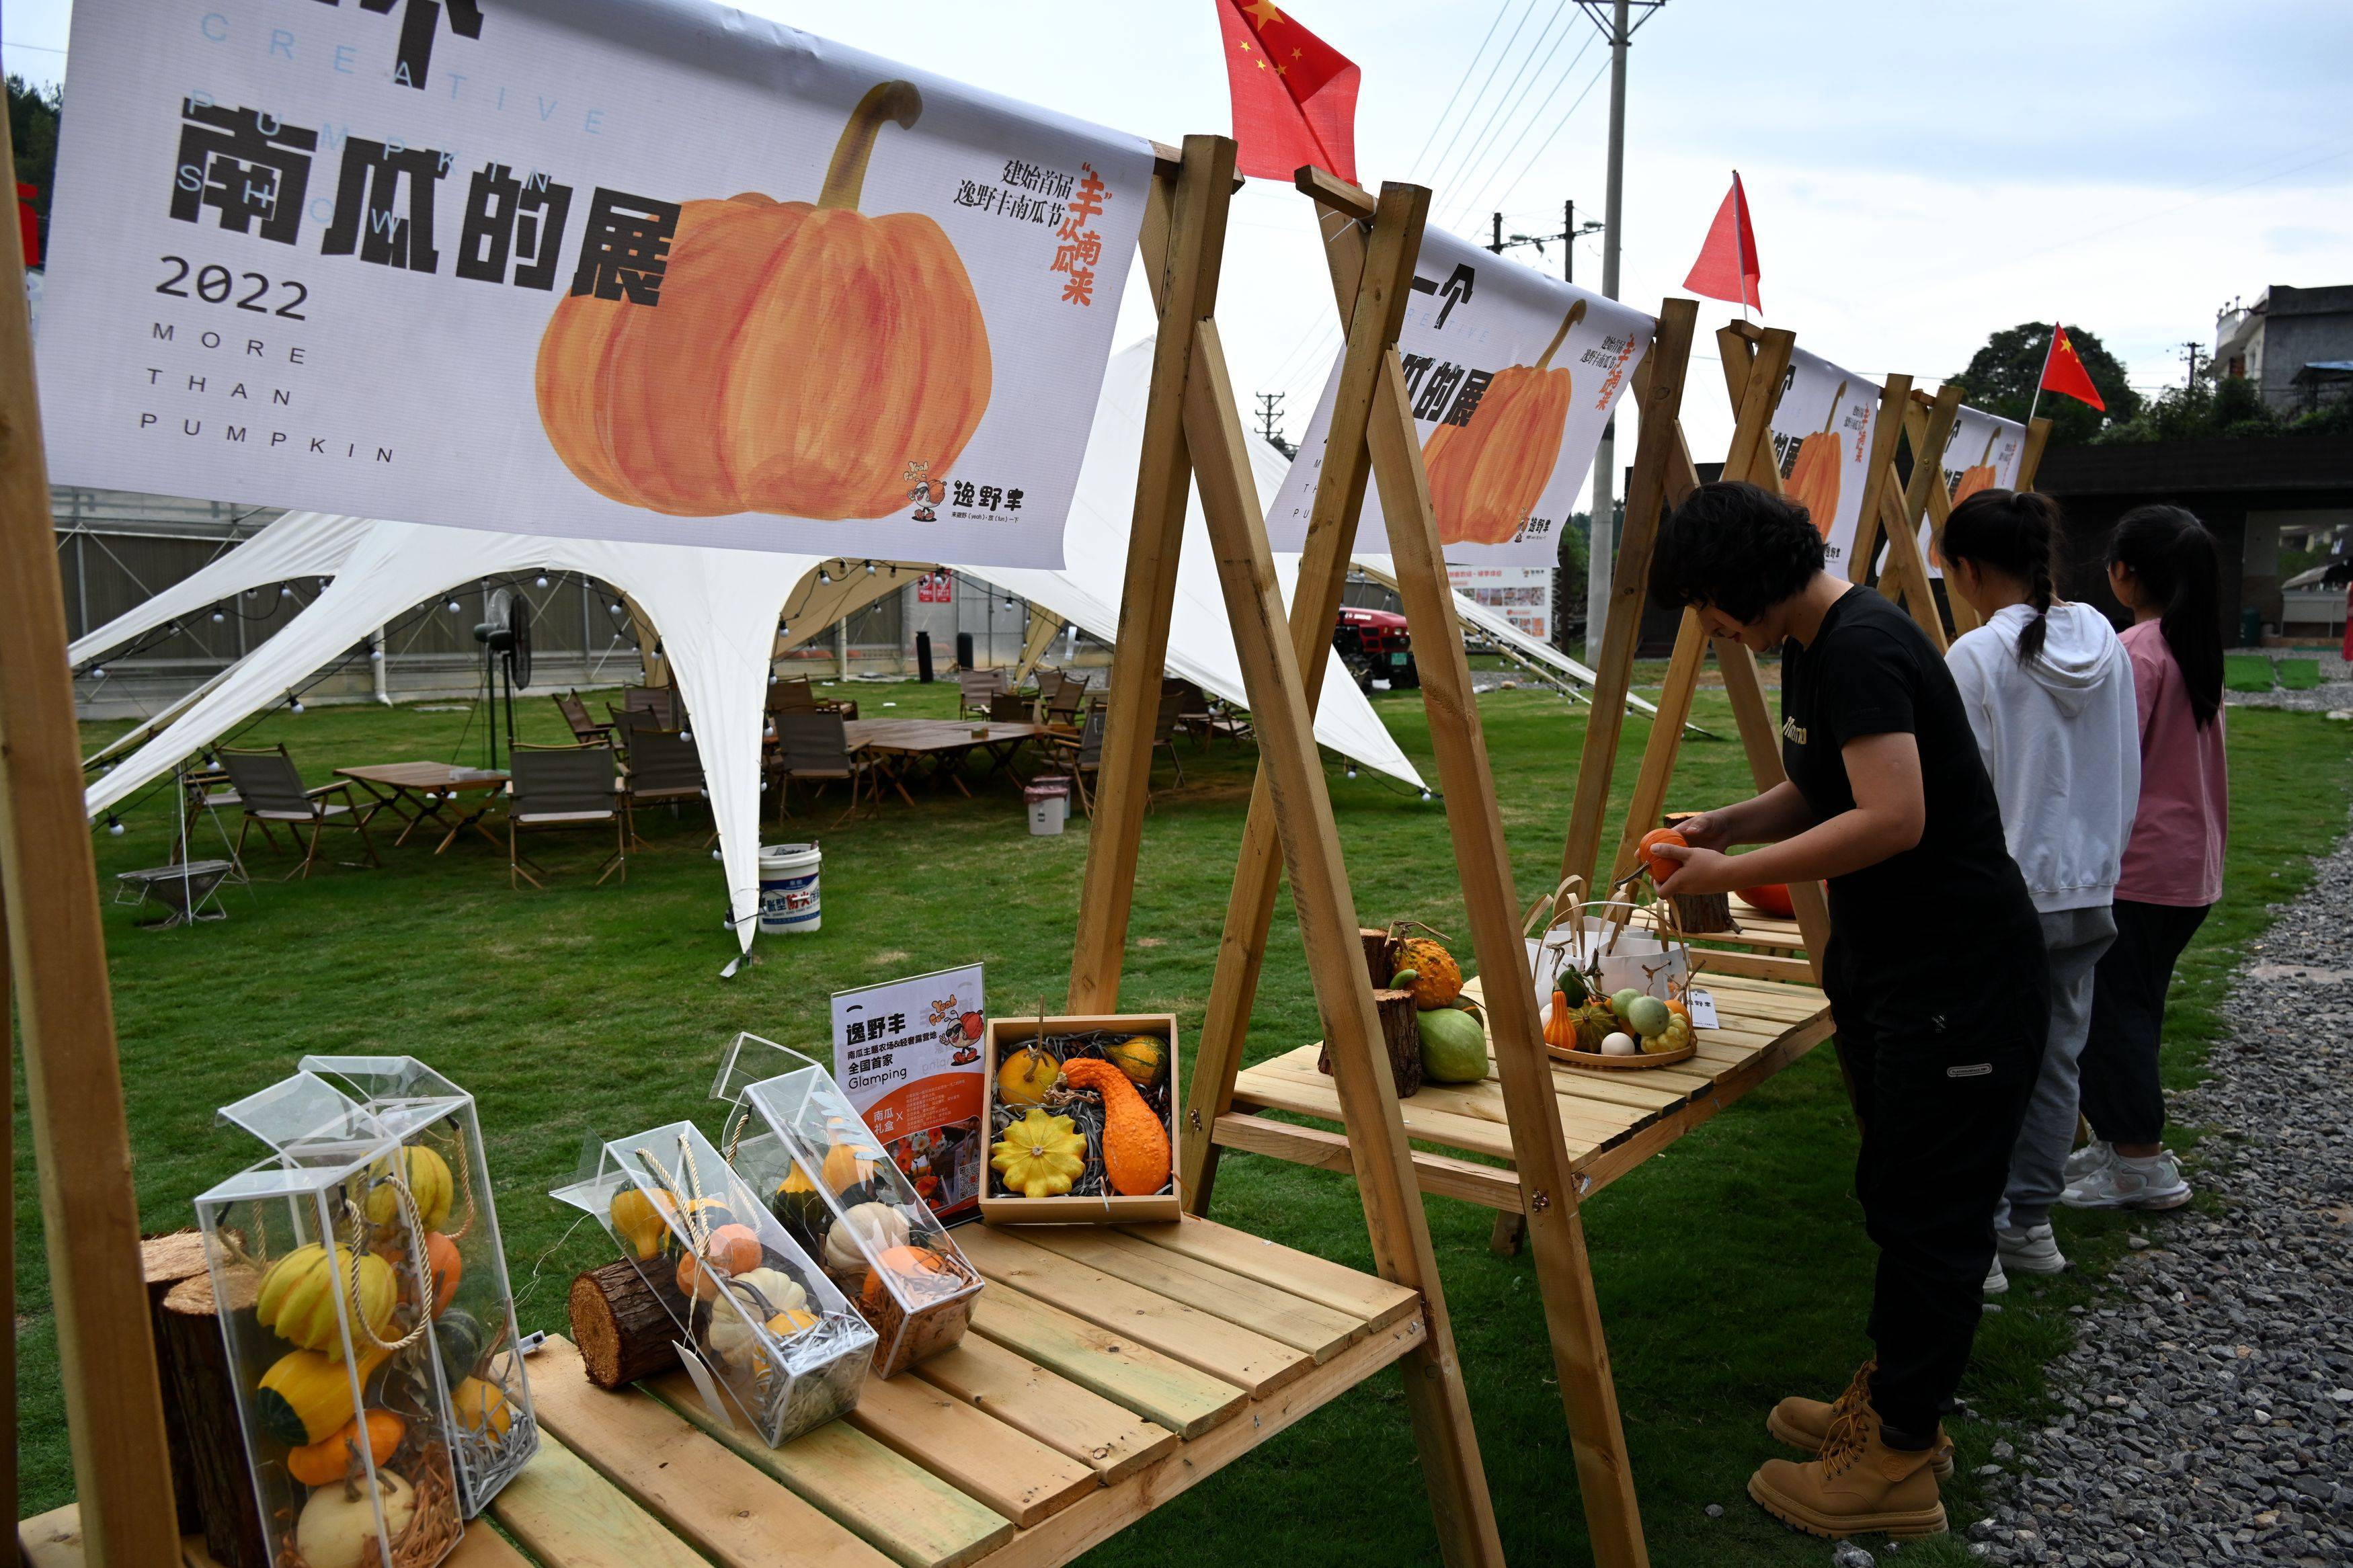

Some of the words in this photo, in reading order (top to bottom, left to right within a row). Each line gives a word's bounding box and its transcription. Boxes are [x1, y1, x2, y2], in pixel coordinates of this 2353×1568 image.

[200, 13, 606, 134] CREATIVE
[1000, 160, 1074, 200] 建始首届
[170, 97, 681, 306] 南瓜的展
[953, 179, 1066, 228] 逸野丰南瓜节
[155, 255, 309, 321] 2022
[1406, 308, 1489, 343] REATIVE
[153, 323, 306, 364] MORE
[147, 368, 290, 405] THAN
[141, 413, 393, 463] PUMPKIN
[953, 480, 1023, 511] 逸野丰
[931, 994, 957, 1013] Yeah
[846, 1013, 906, 1046] 逸野丰
[847, 1030, 937, 1061] 南瓜主题农场&轻奢露营地
[848, 1053, 893, 1075] 全国首家
[848, 1067, 907, 1089] Glamping
[874, 1108, 893, 1122] 南瓜
[875, 1120, 895, 1135] 礼盒
